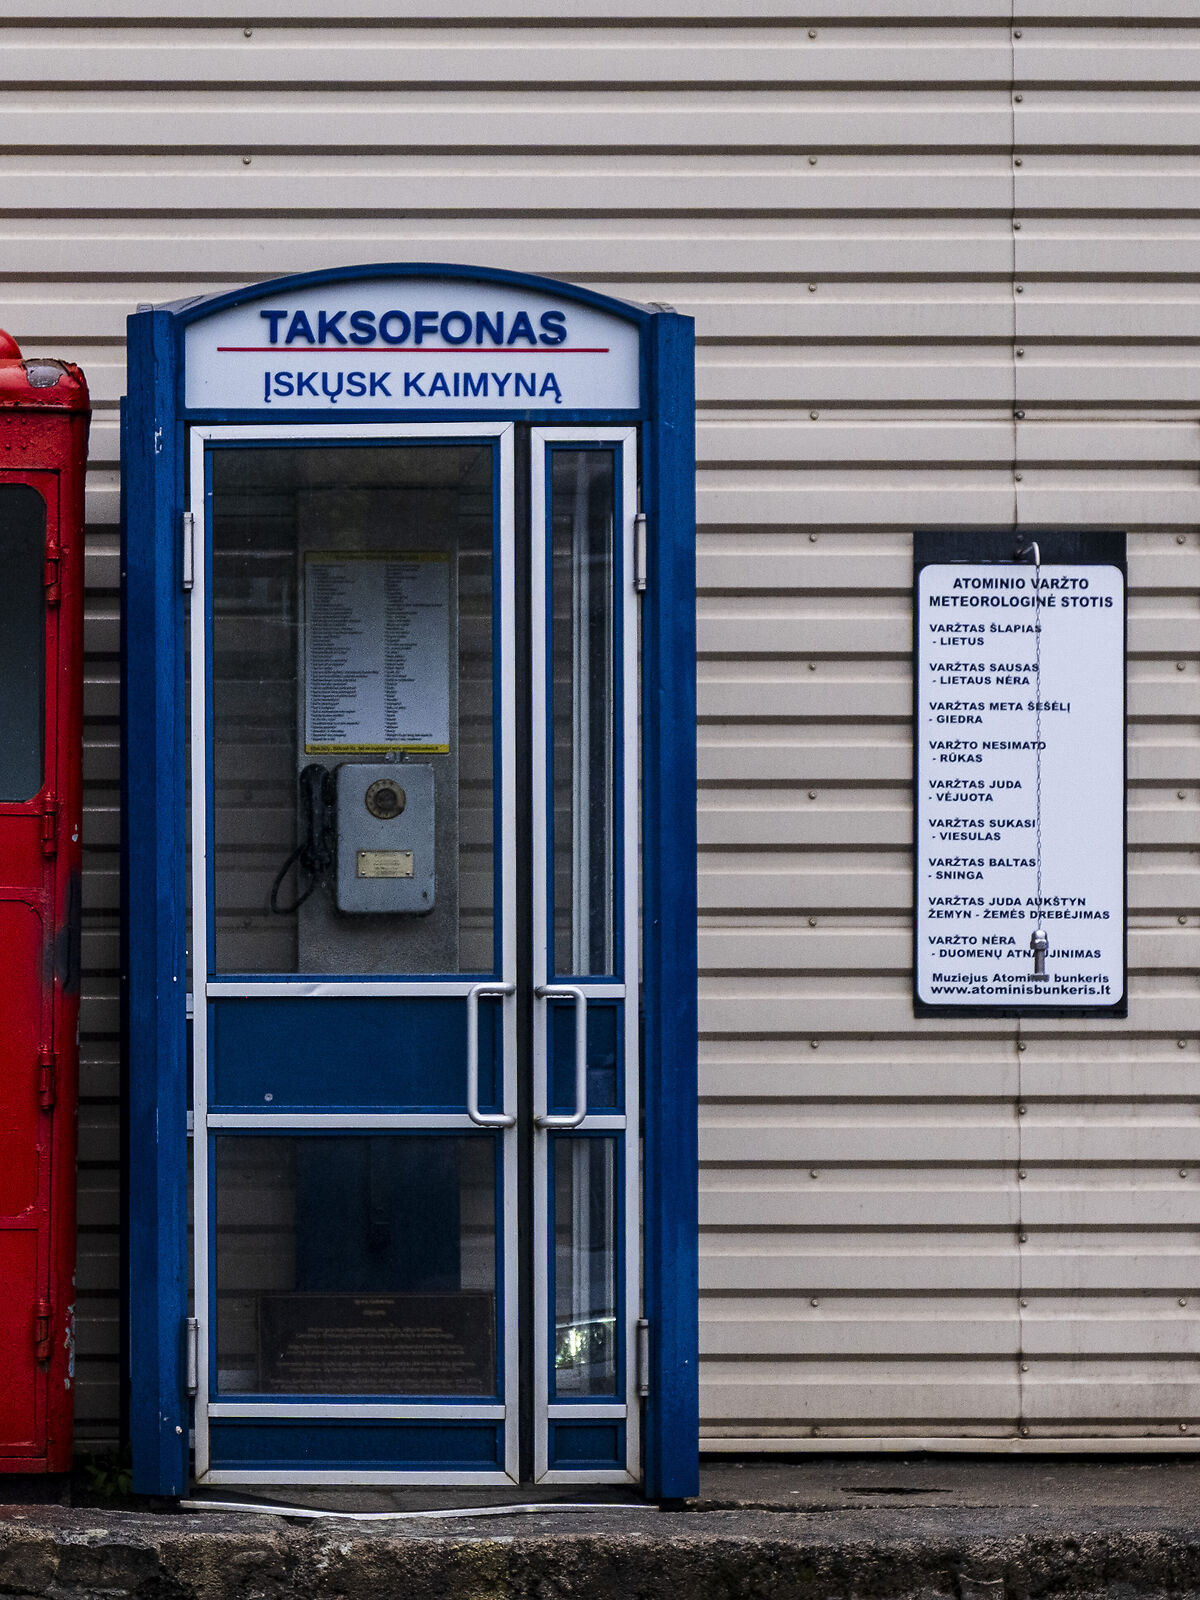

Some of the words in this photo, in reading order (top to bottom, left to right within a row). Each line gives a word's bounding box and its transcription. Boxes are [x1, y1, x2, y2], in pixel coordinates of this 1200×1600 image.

[260, 309, 568, 346] TAKSOFONAS
[264, 371, 393, 403] ĮSKŲSK
[403, 371, 563, 404] KAIMYNĄ
[952, 577, 1026, 590] ATOMINIO
[1030, 575, 1089, 590] VARŽTO
[929, 594, 1056, 608] METEOROLOGINĖ
[1060, 595, 1114, 608] STOTIS
[929, 622, 986, 633] VARŽTAS
[990, 622, 1042, 633] ŠLAPIAS
[940, 636, 985, 646] LIETUS
[929, 661, 986, 673] VARŽTAS
[989, 663, 1040, 673] SAUSAS
[940, 676, 992, 686] LIETAUS
[996, 675, 1030, 686] NĖRA
[929, 701, 986, 712] VARŽTAS
[989, 702, 1023, 712] META
[936, 715, 983, 724] GIEDRA
[929, 739, 978, 750] VARŽTO
[982, 741, 1047, 750] NESIMATO
[929, 778, 985, 789] VARŽTAS
[988, 780, 1022, 789] JUDA
[936, 791, 994, 802] VĖJUOTA
[929, 817, 985, 828] VARŽTAS
[989, 819, 1036, 828] SUKASI
[939, 831, 1001, 841] VIESULAS
[928, 856, 985, 867] VARŽTAS
[989, 858, 1037, 867] BALTAS
[936, 871, 984, 880] SNINGA
[928, 895, 985, 906] VARŽTAS
[988, 897, 1022, 906] JUDA
[1026, 896, 1086, 906] AUKŠTYN
[928, 908, 972, 919] ŽEMYN
[983, 908, 1026, 919] ŽEMĖS
[1029, 909, 1110, 919] DREBĖJIMAS
[928, 935, 978, 945] VARŽTO
[982, 934, 1016, 945] NĖRA
[939, 949, 1002, 960] DUOMENŲ
[932, 973, 989, 984] Muziejus
[992, 974, 1050, 983] Atomi
[1053, 974, 1110, 983] bunkeris
[930, 985, 1112, 995] www.atominisbunkeris.lt
